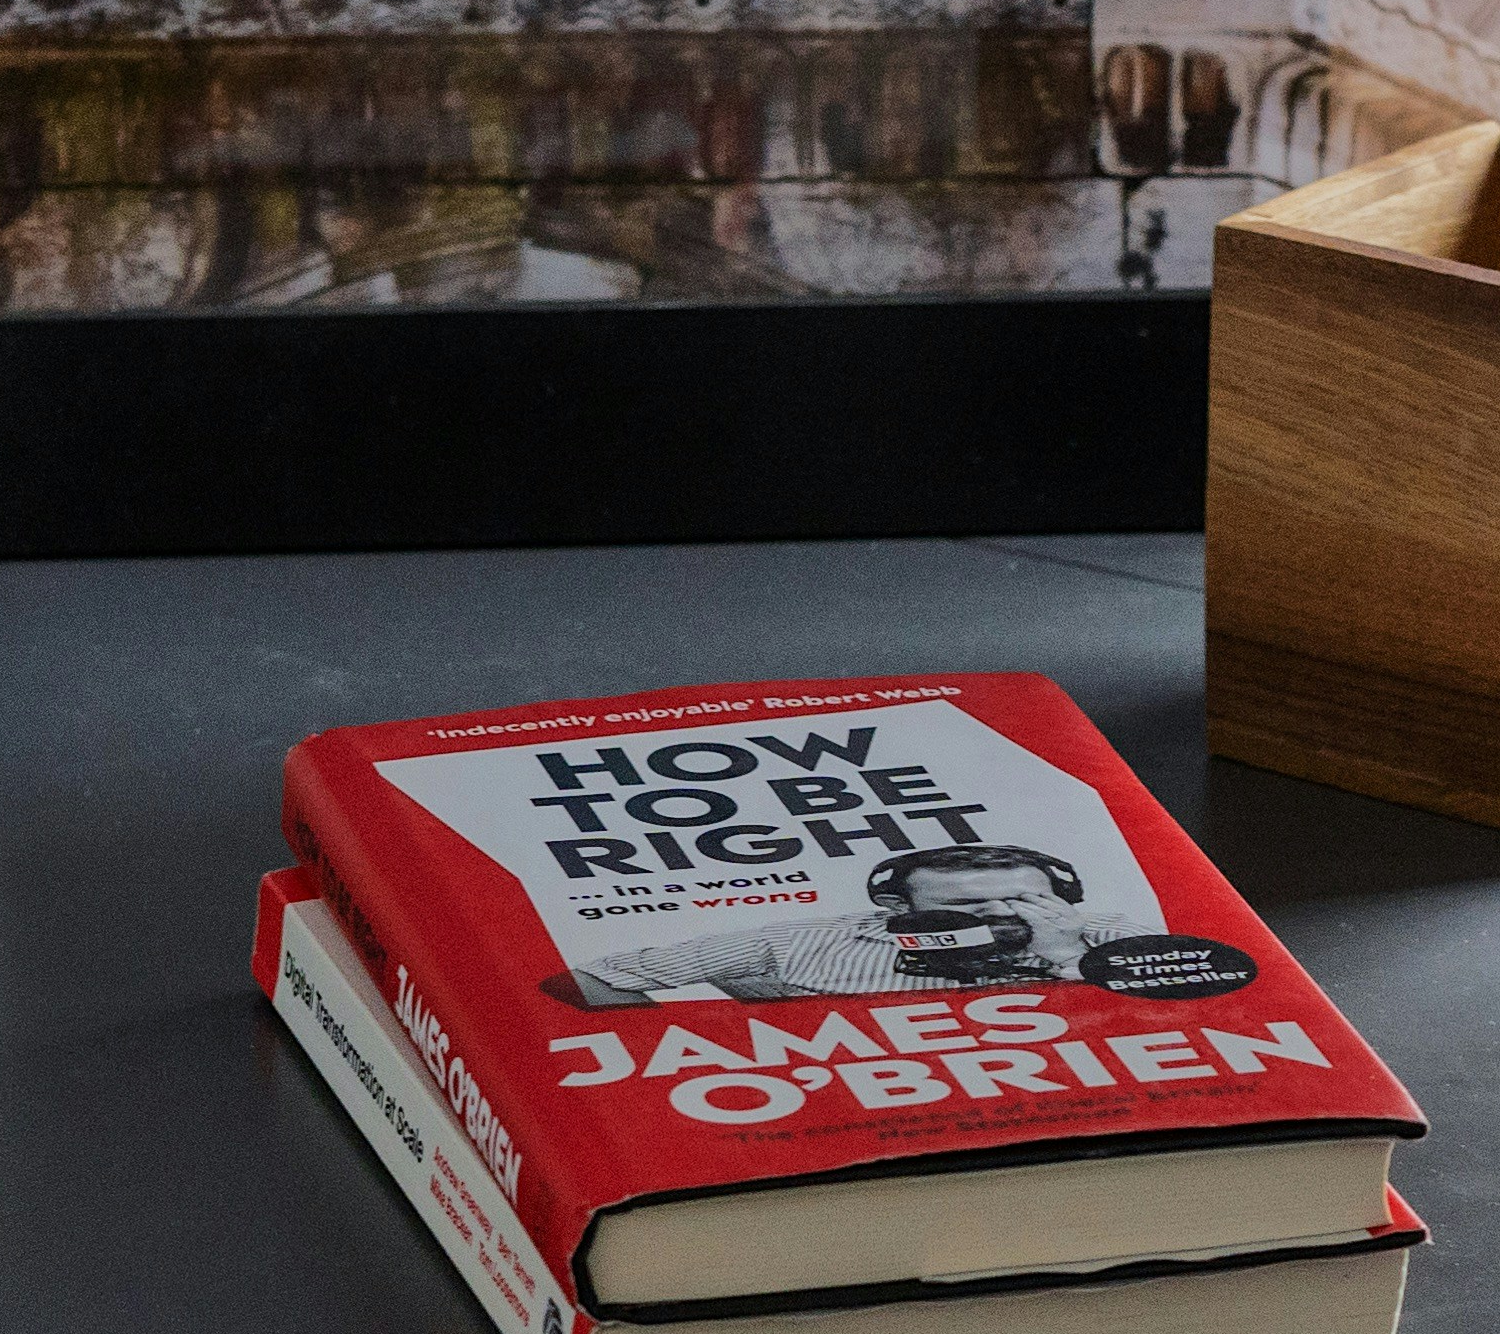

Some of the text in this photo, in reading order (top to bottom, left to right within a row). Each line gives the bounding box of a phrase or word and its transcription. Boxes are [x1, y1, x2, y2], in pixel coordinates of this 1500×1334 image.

[426, 684, 962, 740] 'Indecently enjoyable' Robert Webb
[535, 727, 878, 791] HOW
[528, 765, 952, 832] TO BE
[545, 803, 989, 879] RIGHT
[577, 888, 819, 920] gone wrong
[613, 882, 652, 898] in
[663, 883, 687, 894] a
[694, 870, 812, 890] world
[899, 931, 957, 948] LBC
[1107, 947, 1213, 966] Sunday
[1128, 960, 1213, 976] Times
[1107, 968, 1249, 992] Bestseller
[284, 950, 425, 1164] Digital Transformation at Scale
[549, 994, 1070, 1087] JAMES
[393, 965, 522, 1207] JAMES O'BRIEN
[669, 1021, 1333, 1125] O'BRIEN
